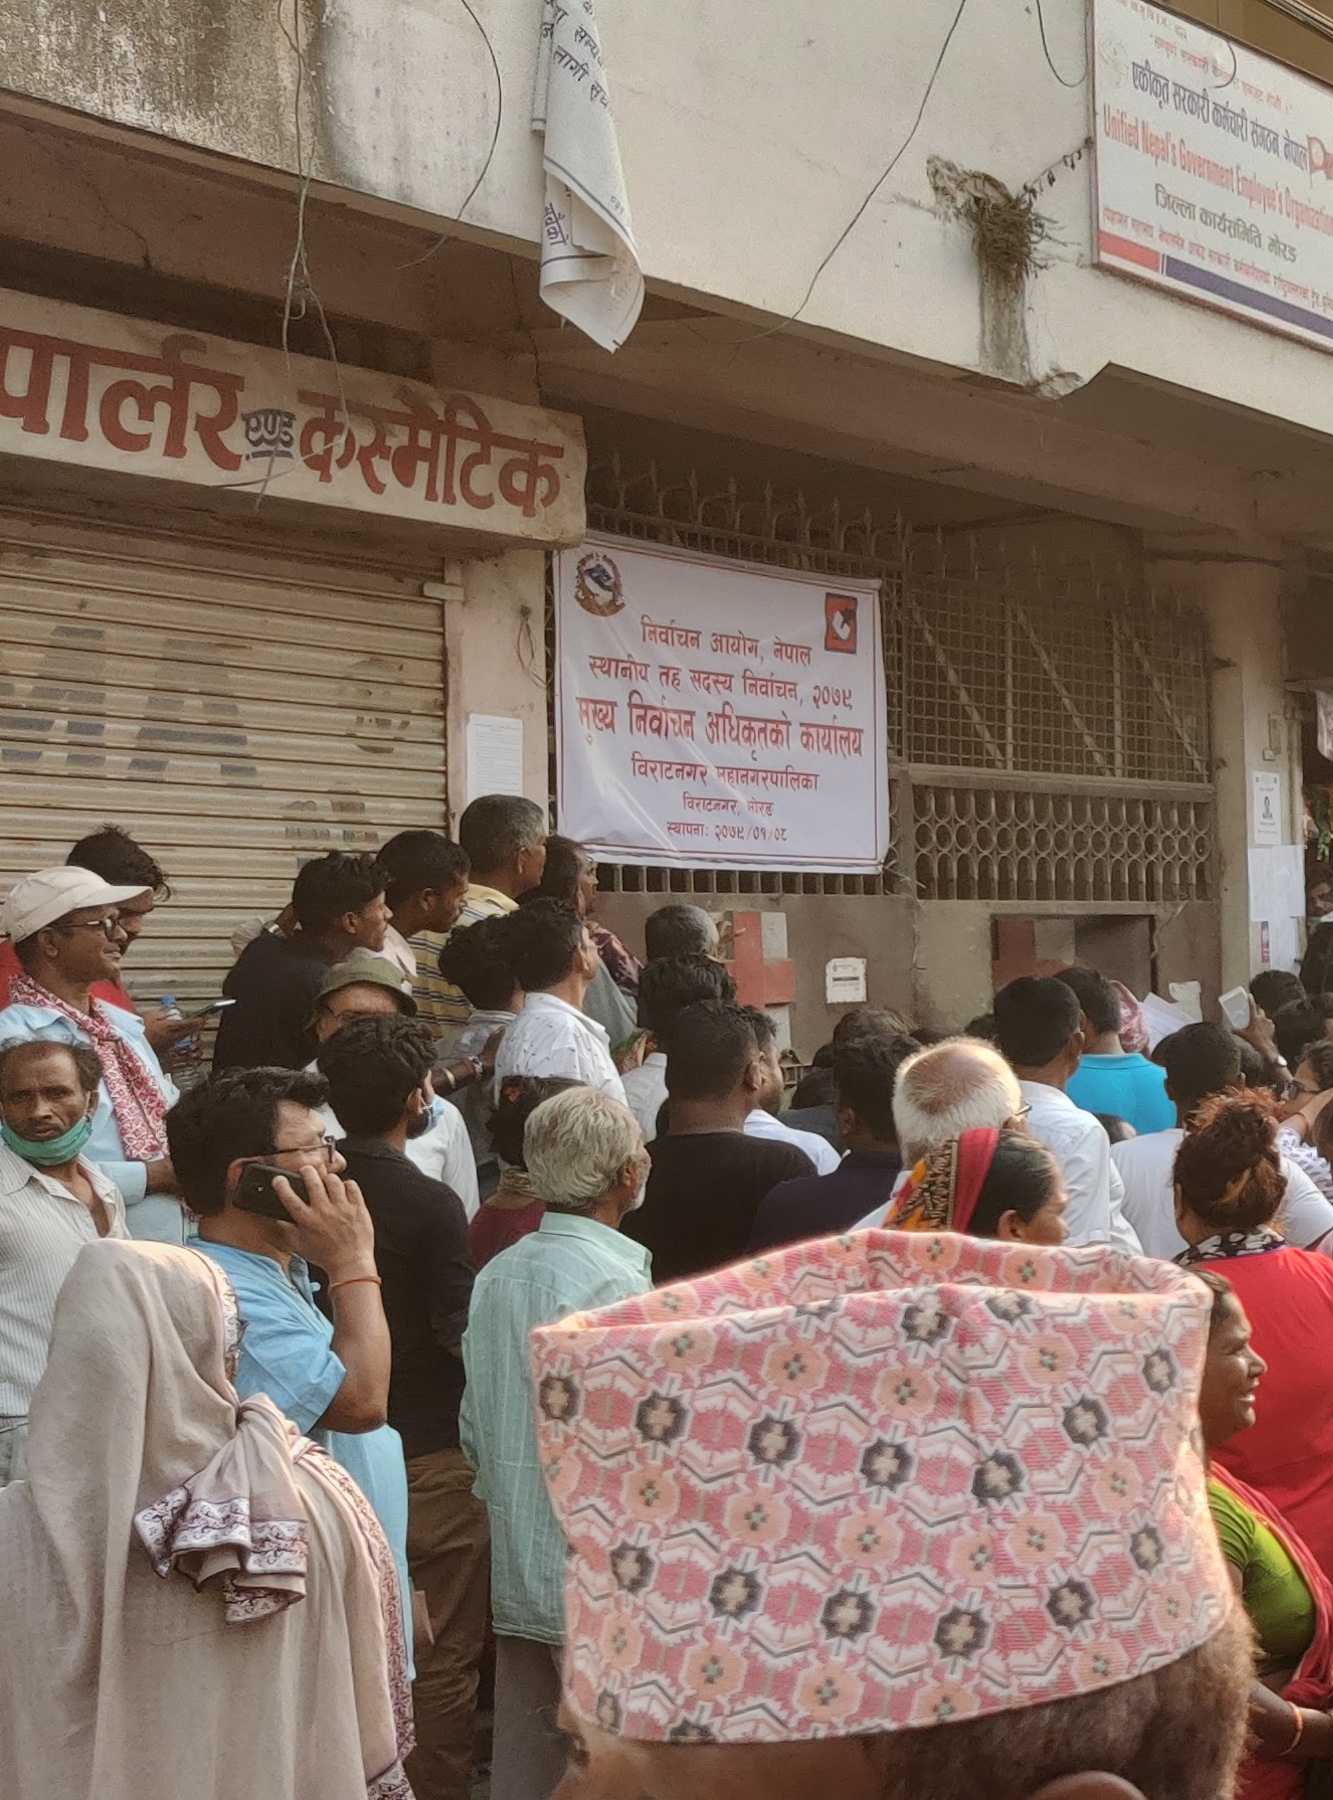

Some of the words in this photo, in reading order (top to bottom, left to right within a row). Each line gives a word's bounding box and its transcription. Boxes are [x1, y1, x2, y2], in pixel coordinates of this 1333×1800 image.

[1173, 88, 1210, 123] सरकारी
[1103, 103, 1139, 150] Unified
[1179, 138, 1234, 192] Government
[1155, 183, 1196, 222] जिल्ला
[0, 325, 246, 471] पार्लर
[641, 614, 702, 650] निर्वाचन
[774, 635, 812, 667] नेपाल
[659, 665, 681, 693] तह
[689, 669, 735, 695] सदस्य
[575, 696, 618, 745] मुख्य
[627, 689, 696, 741] निर्वाचन
[705, 700, 792, 761] अधिकृतको
[799, 714, 865, 759] कार्यालय
